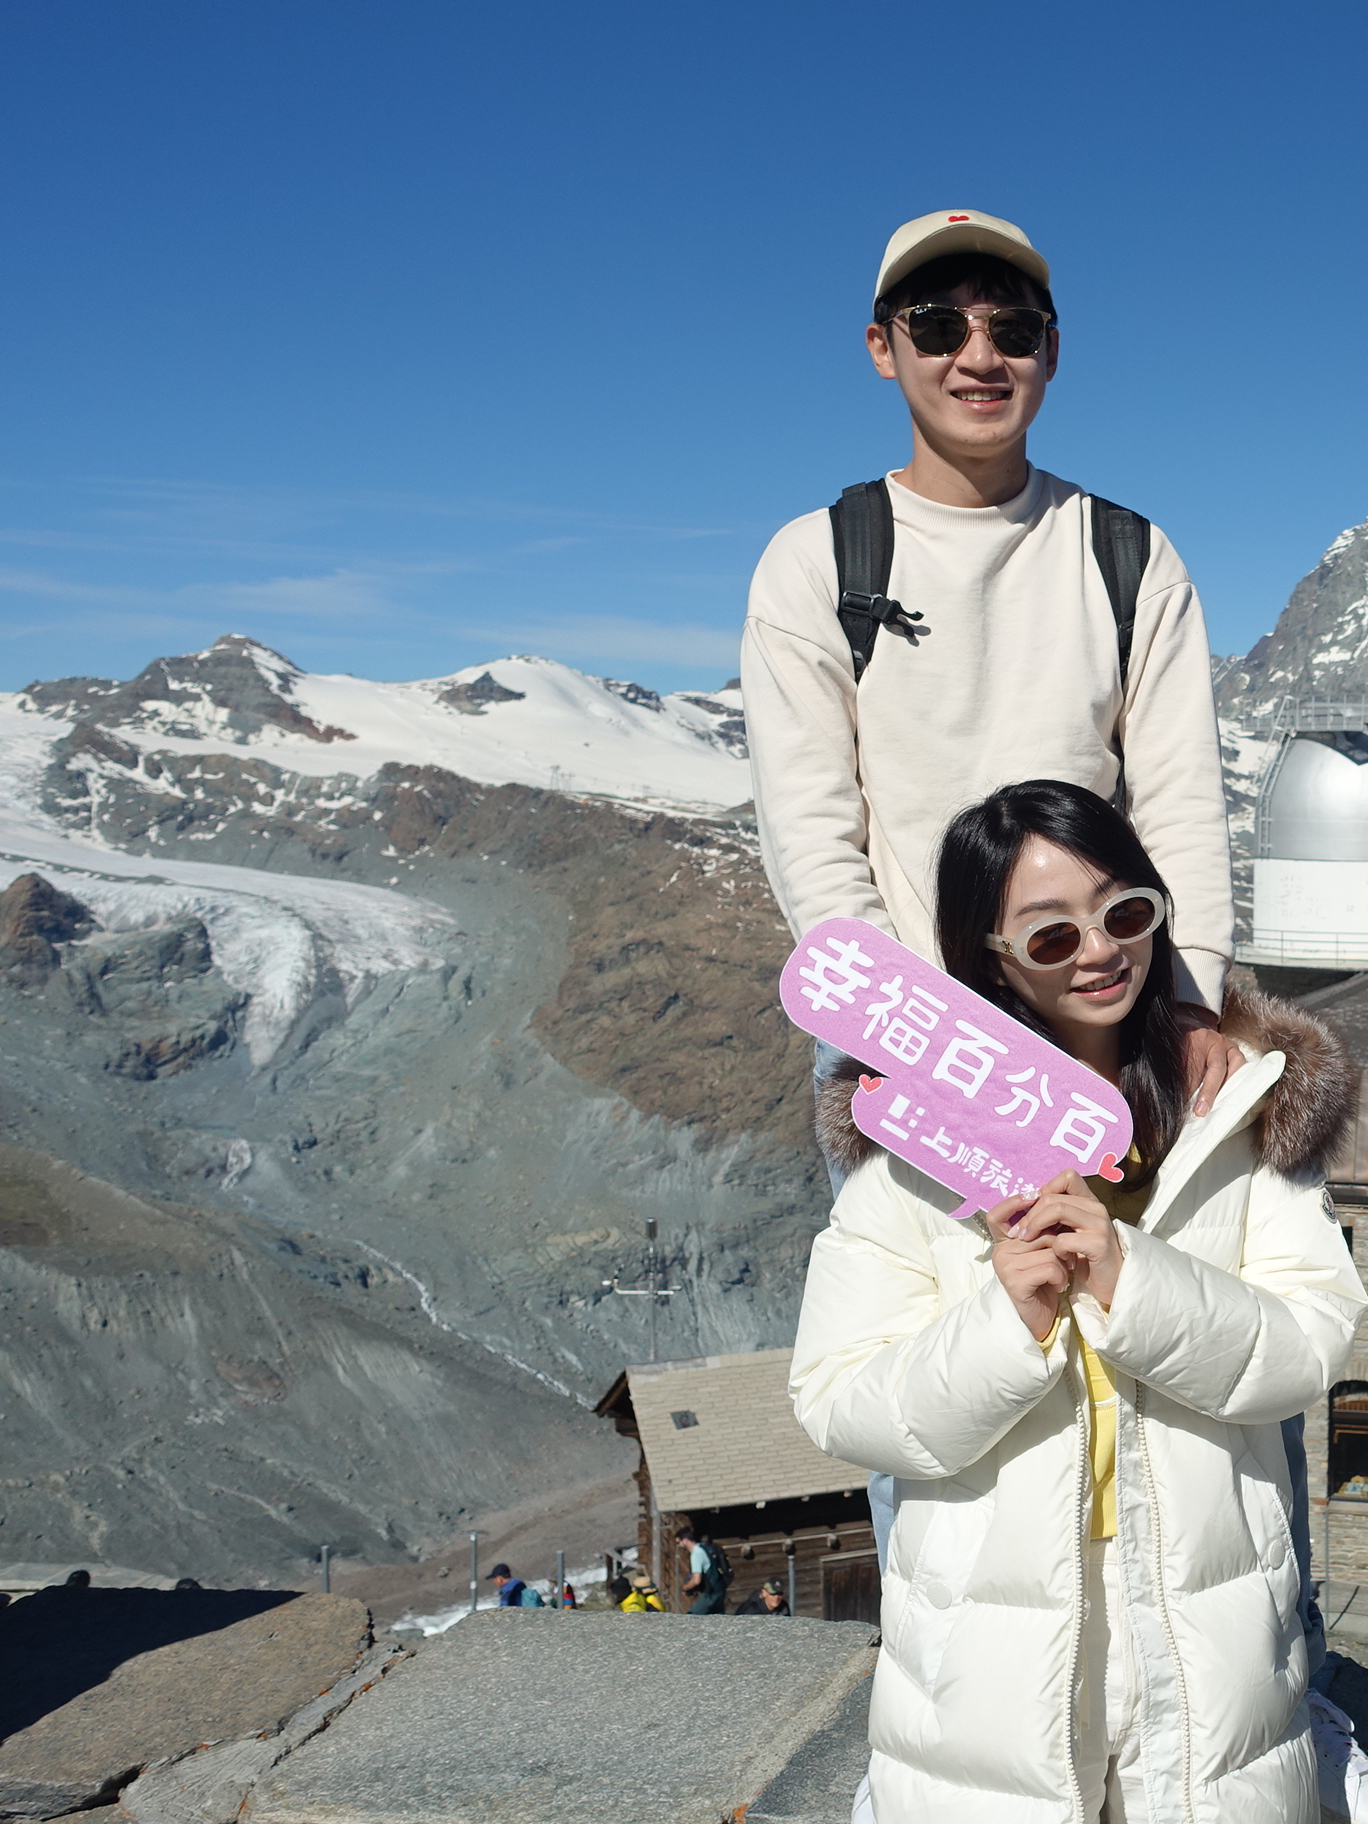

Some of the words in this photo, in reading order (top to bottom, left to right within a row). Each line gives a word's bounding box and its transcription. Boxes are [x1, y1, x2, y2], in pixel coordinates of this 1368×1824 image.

[799, 936, 1119, 1164] 幸福百分百
